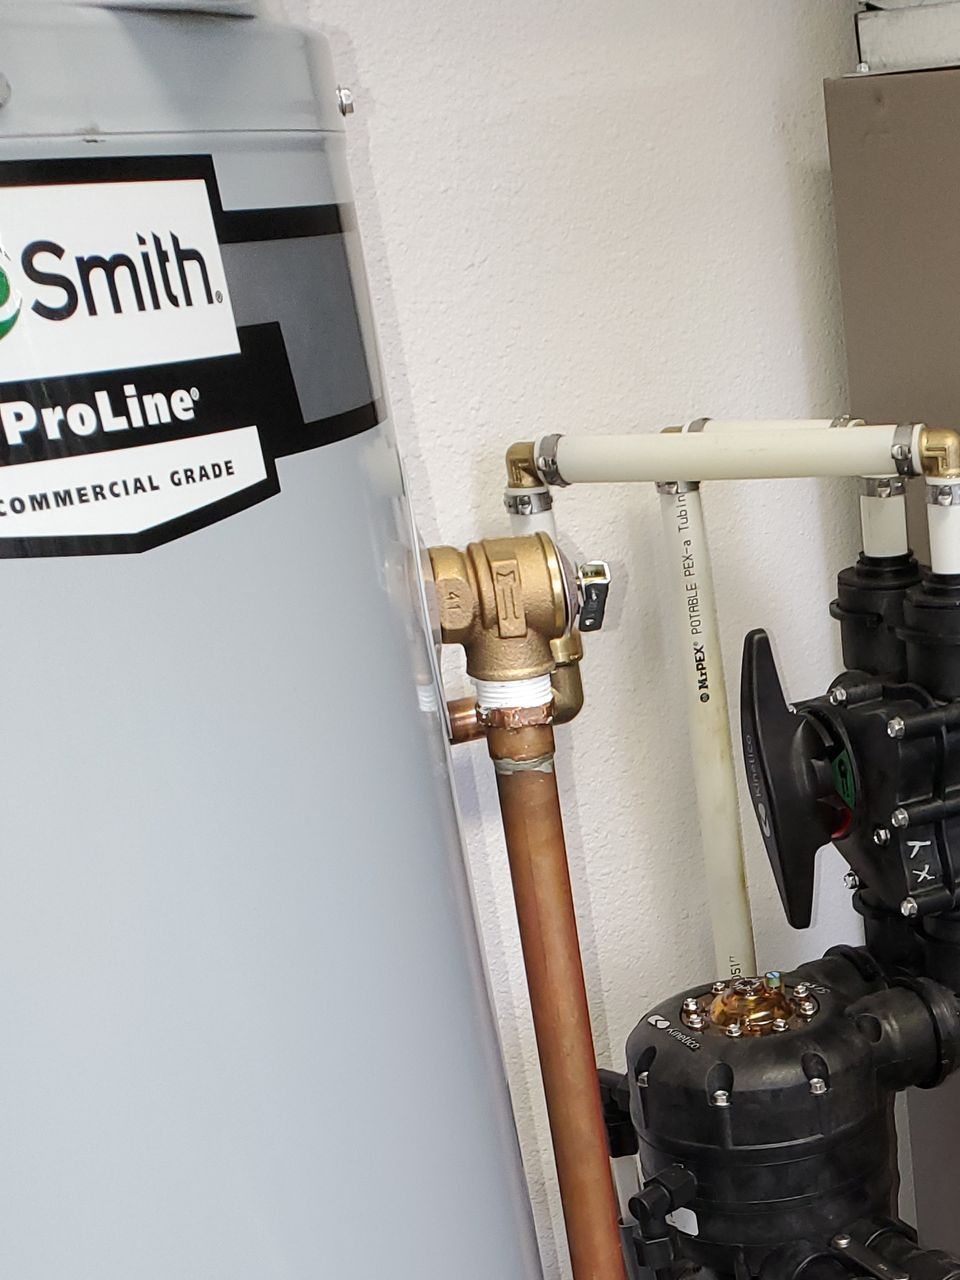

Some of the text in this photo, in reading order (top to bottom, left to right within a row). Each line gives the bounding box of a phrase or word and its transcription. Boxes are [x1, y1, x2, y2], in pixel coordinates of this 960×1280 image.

[170, 460, 235, 487] GRADE
[676, 492, 689, 532] Tubin
[681, 539, 696, 577] PEX-a
[686, 583, 702, 635] POTABLE
